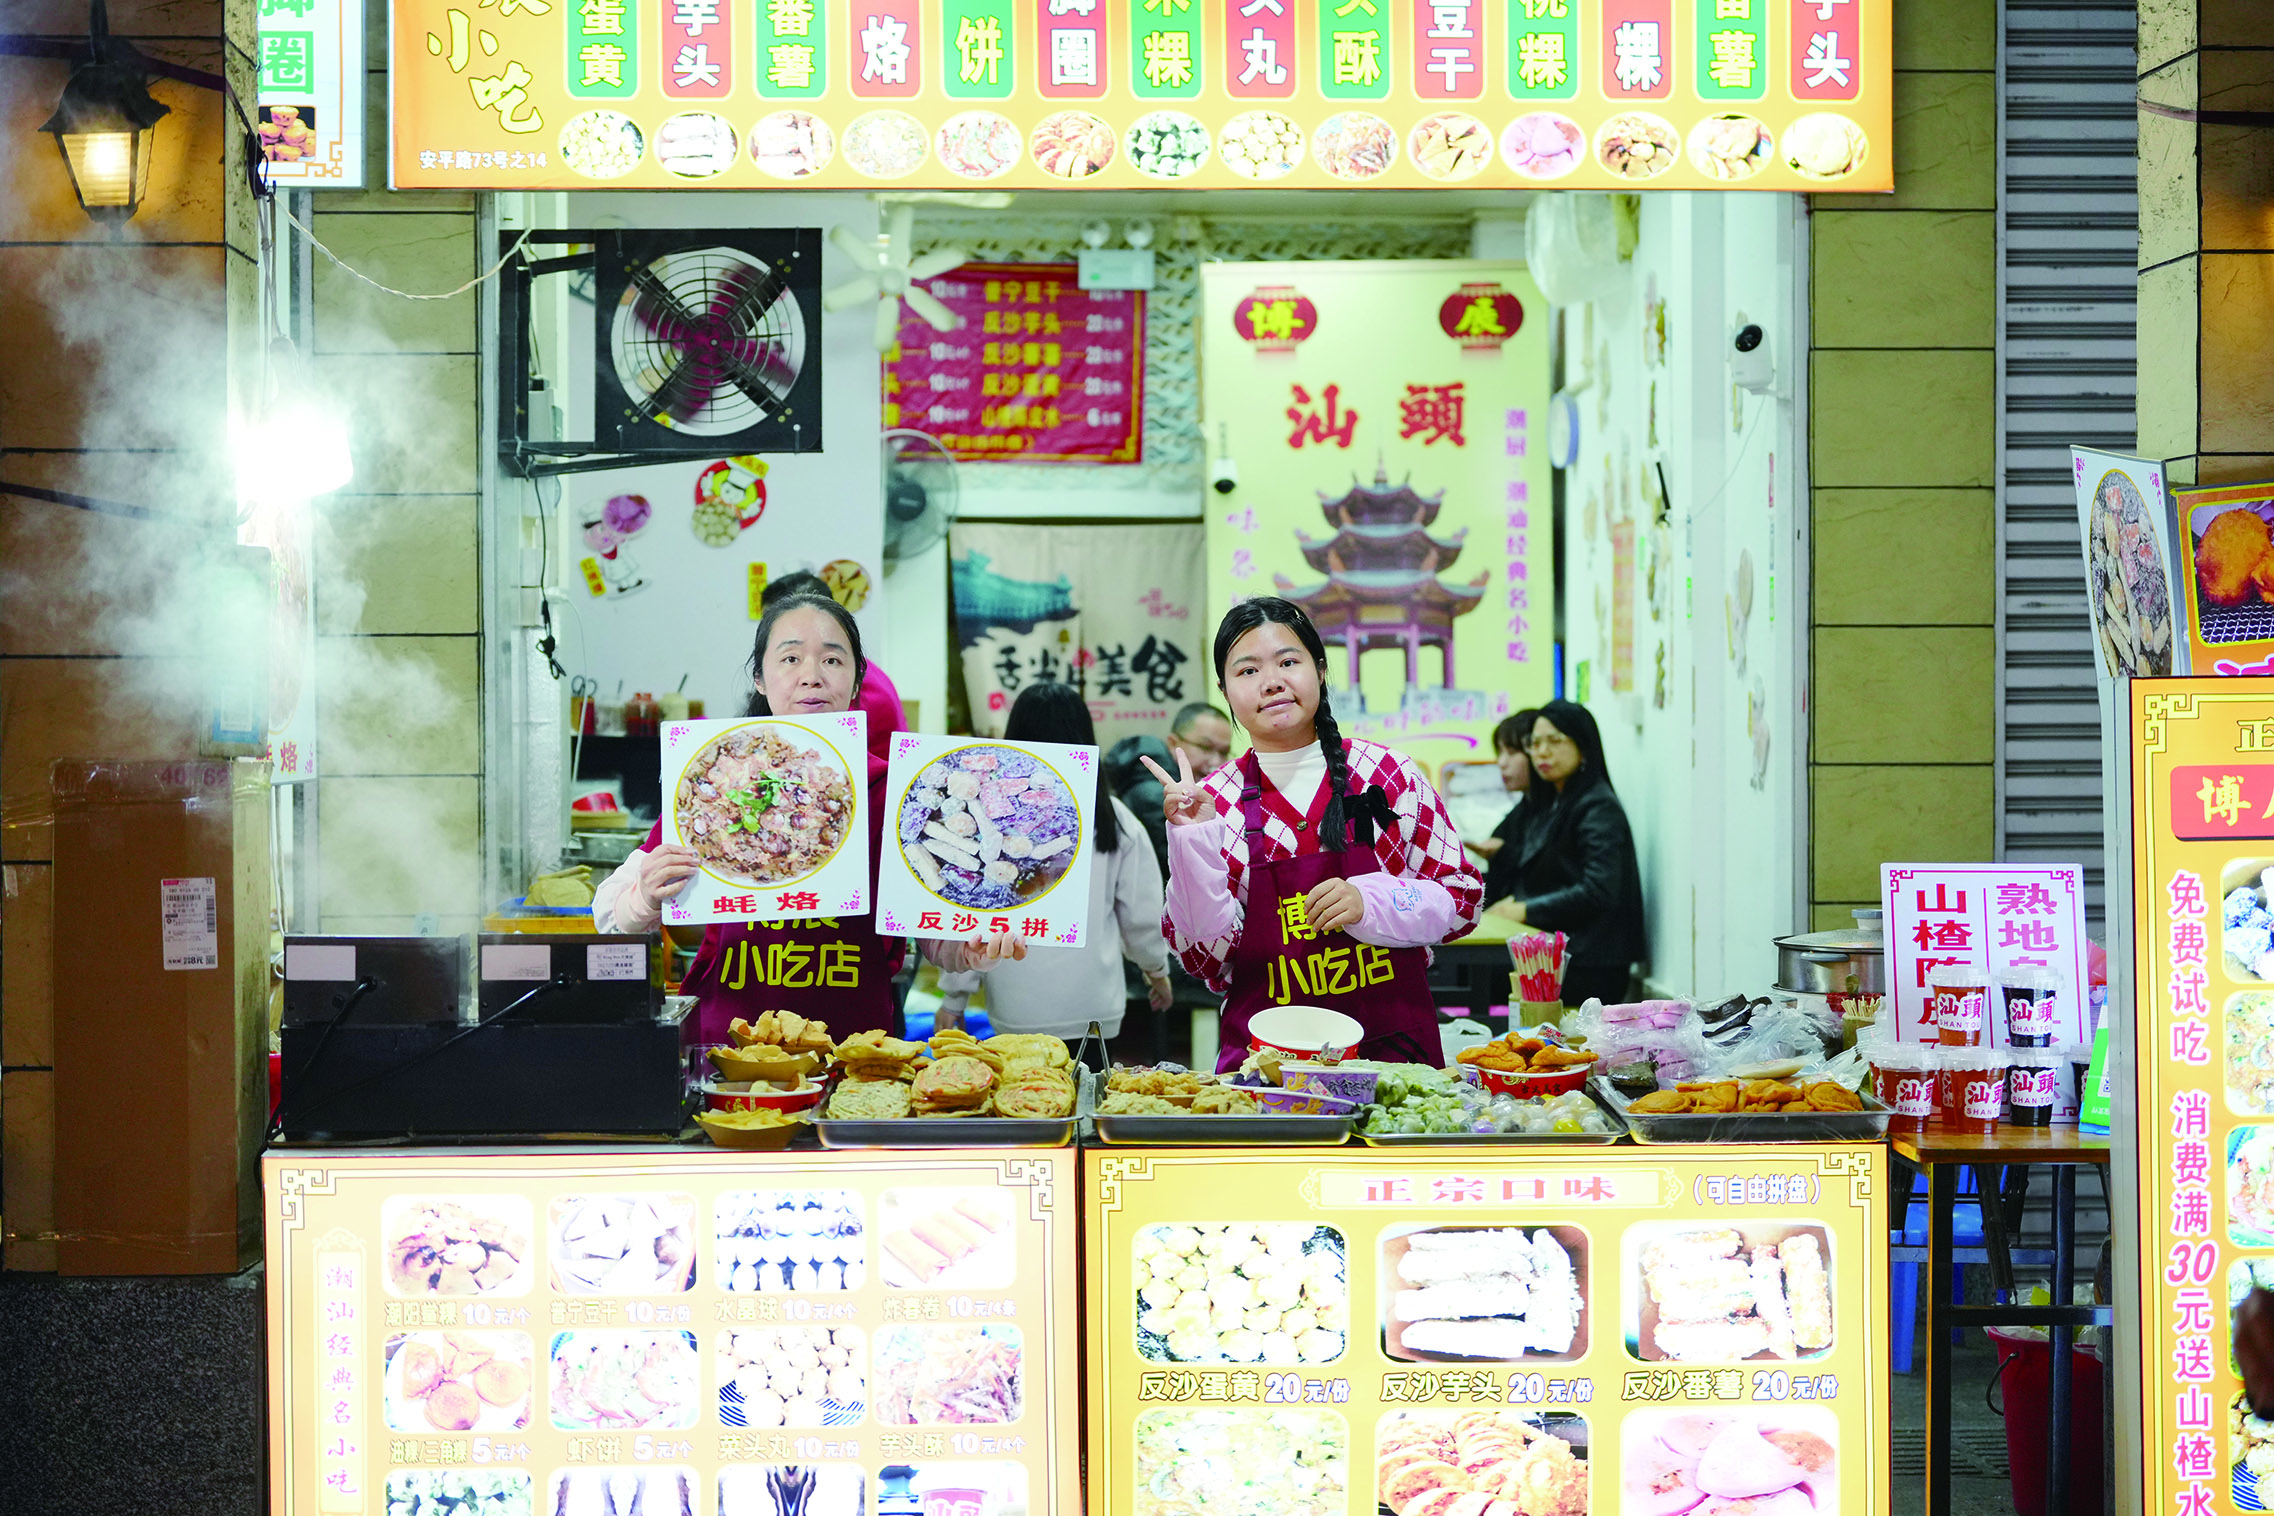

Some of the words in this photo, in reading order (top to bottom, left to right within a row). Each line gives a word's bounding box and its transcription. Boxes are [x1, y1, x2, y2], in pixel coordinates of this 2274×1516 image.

[578, 0, 627, 88] 蛋黄
[766, 0, 816, 88] 番薯
[860, 14, 911, 85] 烙
[955, 15, 1004, 85] 饼
[1424, 0, 1476, 92] 豆干
[1613, 21, 1663, 91] 粿
[427, 0, 553, 134] 小吃
[419, 151, 549, 171] 安平路73号之14
[1246, 301, 1306, 339] 博
[1454, 297, 1506, 336] 展
[1285, 381, 1467, 449] 汕頭
[2196, 773, 2274, 827] 博
[712, 891, 821, 915] 蚝烙
[916, 911, 1050, 938] 反沙5拼
[719, 940, 861, 990] 小吃店
[1267, 942, 1395, 1005] 小吃店
[2169, 872, 2208, 1063] 免费试吃
[2011, 1024, 2037, 1034] SHAN
[1897, 1105, 1922, 1115] SHAN
[1966, 1107, 1993, 1116] SHAN
[2012, 1095, 2038, 1104] SHAN
[1360, 1174, 1617, 1203] 正宗口味
[1692, 1173, 1822, 1206] （可自由拼盘）
[461, 1302, 532, 1327] 10元/个
[550, 1299, 618, 1326] 普宁豆干
[623, 1300, 692, 1325] 10元/份
[713, 1297, 779, 1323] 水晶球
[881, 1295, 942, 1322] 炸春卷
[2167, 1092, 2217, 1516] 消费满30元送山楂水
[325, 1265, 358, 1496] 潮汕经典名小吃
[1137, 1371, 1261, 1402] 反沙蛋黄
[1263, 1372, 1351, 1404] 20元/份
[1379, 1371, 1503, 1402] 反沙芋头
[1506, 1372, 1595, 1403] 20元/份
[1620, 1369, 1745, 1401] 反沙番薯
[1750, 1370, 1840, 1402] 20元/份
[470, 1437, 532, 1464] 5元/个
[566, 1437, 623, 1463] 虾饼
[631, 1434, 695, 1462] 5元/个
[717, 1432, 792, 1460] 菜头丸
[792, 1435, 861, 1460] 10元/份
[877, 1431, 945, 1458] 芋头酥
